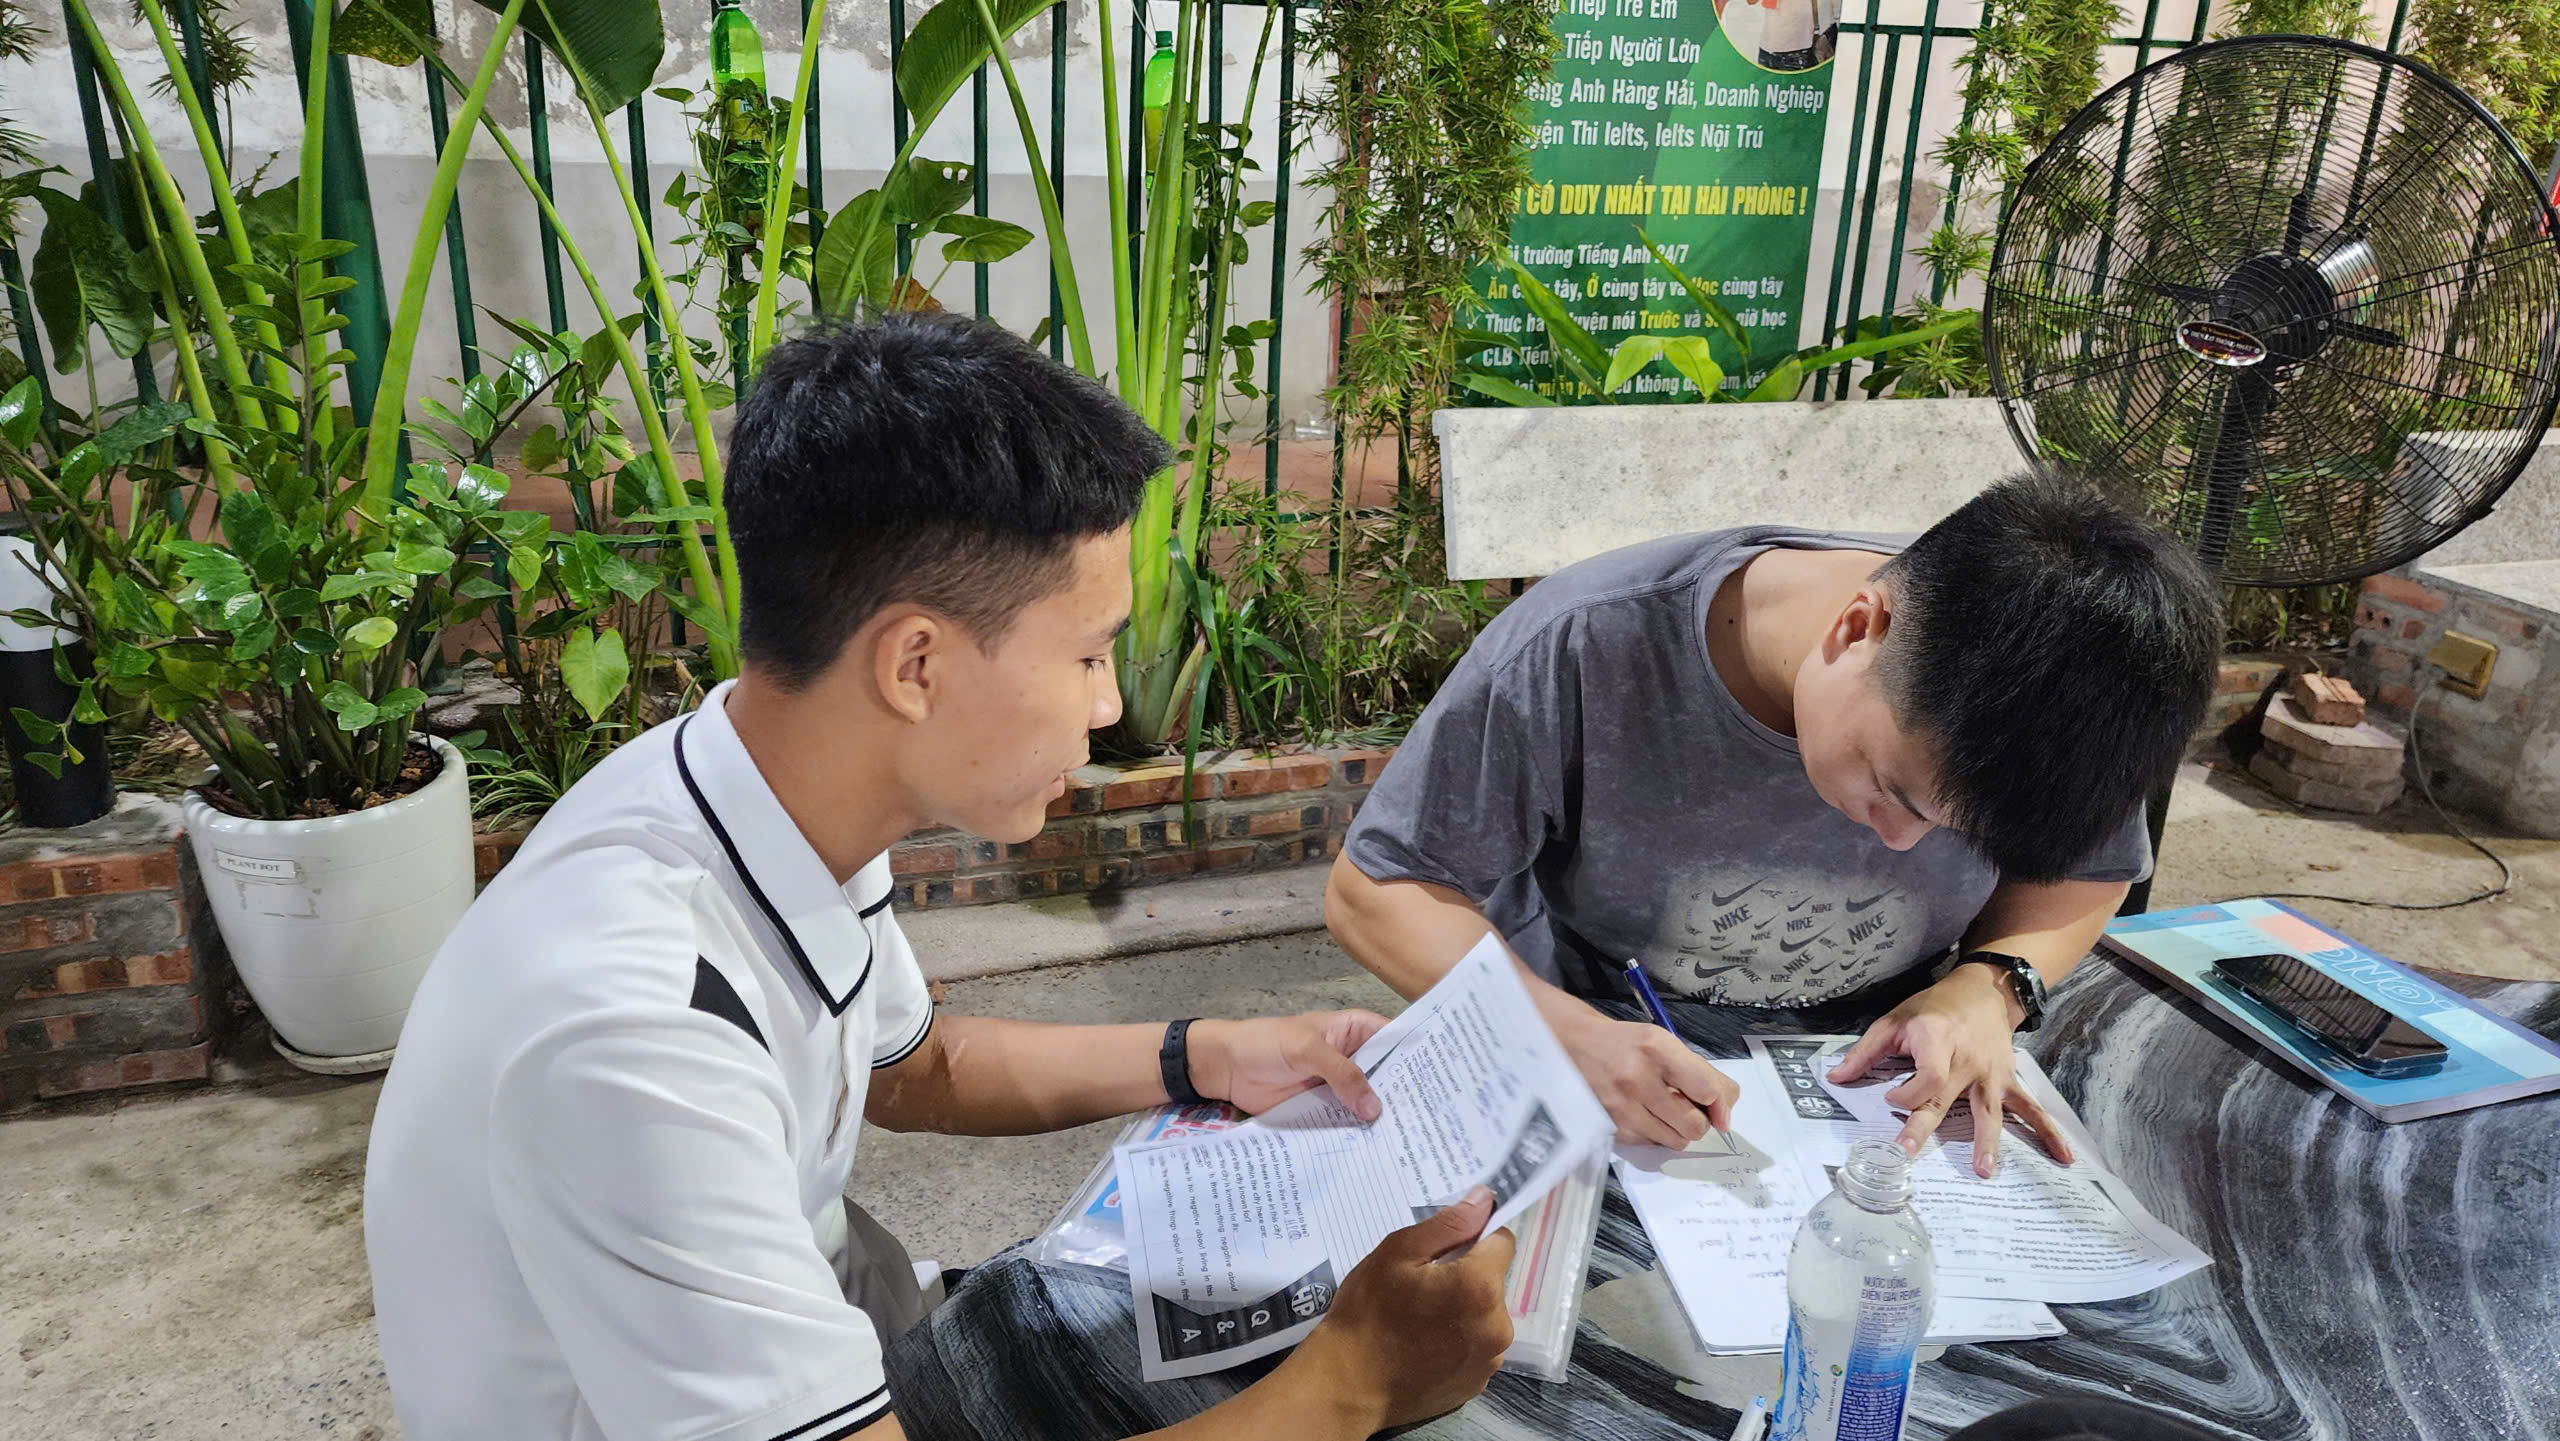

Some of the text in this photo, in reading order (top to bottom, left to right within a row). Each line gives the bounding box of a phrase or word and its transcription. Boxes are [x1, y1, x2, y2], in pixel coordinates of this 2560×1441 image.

[1650, 0, 1678, 19] Em
[1565, 30, 1701, 67] Tiếp Người Lớn
[1570, 77, 1605, 103] Anh
[1612, 78, 1660, 110] Hàng
[1665, 79, 1697, 109] Hải,
[1704, 82, 1759, 107] Doanh
[1765, 84, 1824, 114] Nghiệp
[1571, 120, 1598, 145] Thi
[1605, 121, 1648, 150] Ielts,
[1656, 122, 1694, 147] Ielts
[1701, 123, 1730, 152] Nội
[1736, 125, 1764, 148] Trú
[1526, 180, 1555, 215] CÓ
[1559, 184, 1601, 215] DUY
[1604, 175, 1657, 215] NHẤT
[1661, 184, 1692, 220] TẠI
[1695, 177, 1729, 215] HẢI
[1732, 181, 1796, 216] PHÒNG
[1523, 244, 1573, 268] trường
[1577, 242, 1619, 268] Tiếng
[1622, 244, 1651, 264] Anh
[1487, 276, 1508, 299] Ăn
[1602, 278, 1639, 301] cùng
[1643, 278, 1666, 301] tây
[1722, 276, 1758, 298] cùng
[1761, 276, 1784, 298] tây
[1612, 310, 1636, 330] nói
[1640, 309, 1680, 329] Trước
[1684, 309, 1701, 328] và
[1760, 308, 1787, 329] học
[1483, 347, 1512, 367] CLB
[1519, 344, 1553, 368] Tiến
[1636, 375, 1680, 396] không
[1713, 904, 1752, 933] NIKE
[1786, 916, 1814, 932] NIKE
[1848, 910, 1887, 945] NIKE
[1783, 949, 1815, 974] NIKE
[1739, 967, 1761, 985] NIKE
[1770, 974, 1793, 983] NIKE
[1803, 978, 1826, 988] NIKE
[1780, 1049, 1795, 1059] A
[1792, 1078, 1812, 1089] Q
[1181, 1309, 1271, 1343] Q & A
